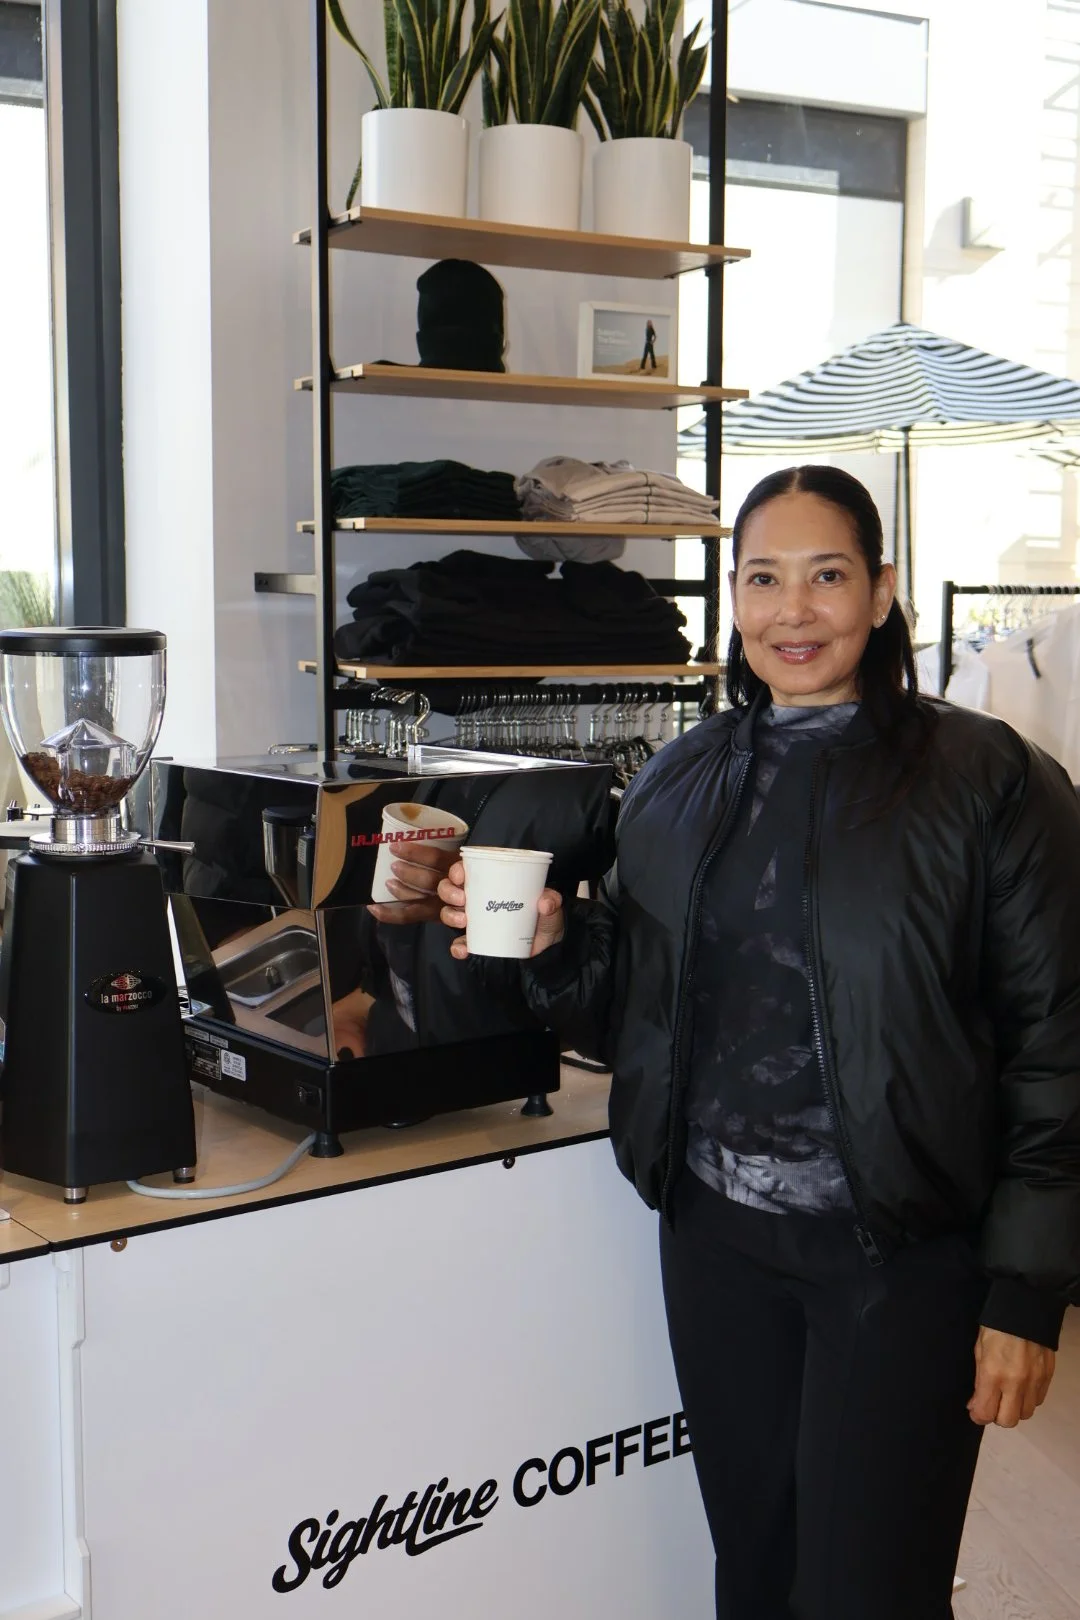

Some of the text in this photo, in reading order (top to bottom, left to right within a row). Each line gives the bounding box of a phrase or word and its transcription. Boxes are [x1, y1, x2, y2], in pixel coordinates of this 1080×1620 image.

[351, 826, 456, 847] LA MARZOCCO
[486, 899, 524, 912] Sightline
[101, 990, 152, 1003] la marzocco
[272, 1411, 694, 1593] Sightline COFFEE
